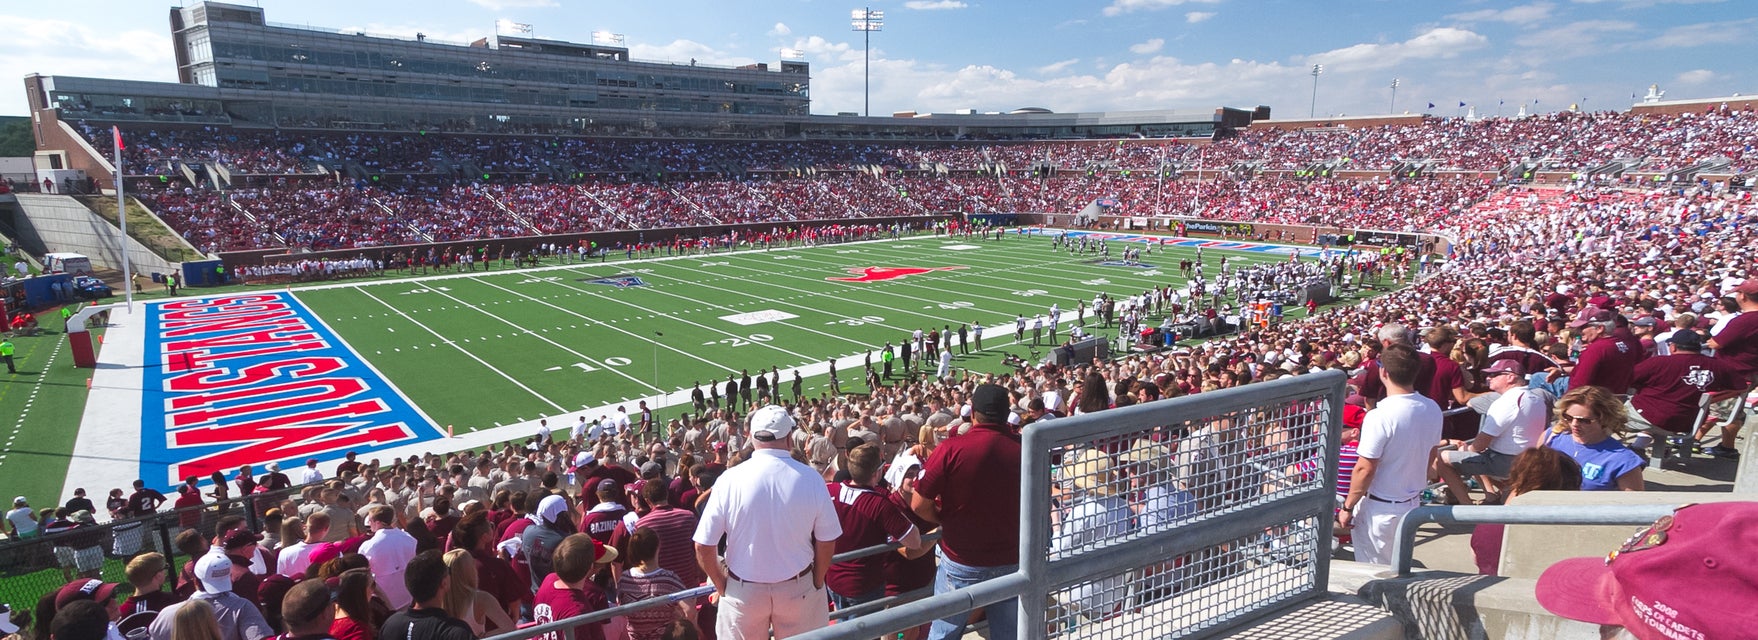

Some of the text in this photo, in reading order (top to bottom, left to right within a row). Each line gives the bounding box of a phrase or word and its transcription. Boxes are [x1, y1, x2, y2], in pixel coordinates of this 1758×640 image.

[720, 333, 774, 347] 20
[571, 356, 632, 372] 10
[158, 294, 418, 486] MUSTANGS
[141, 497, 151, 510] 2
[1653, 601, 1678, 618] 2008
[1665, 618, 1706, 640] CADETS
